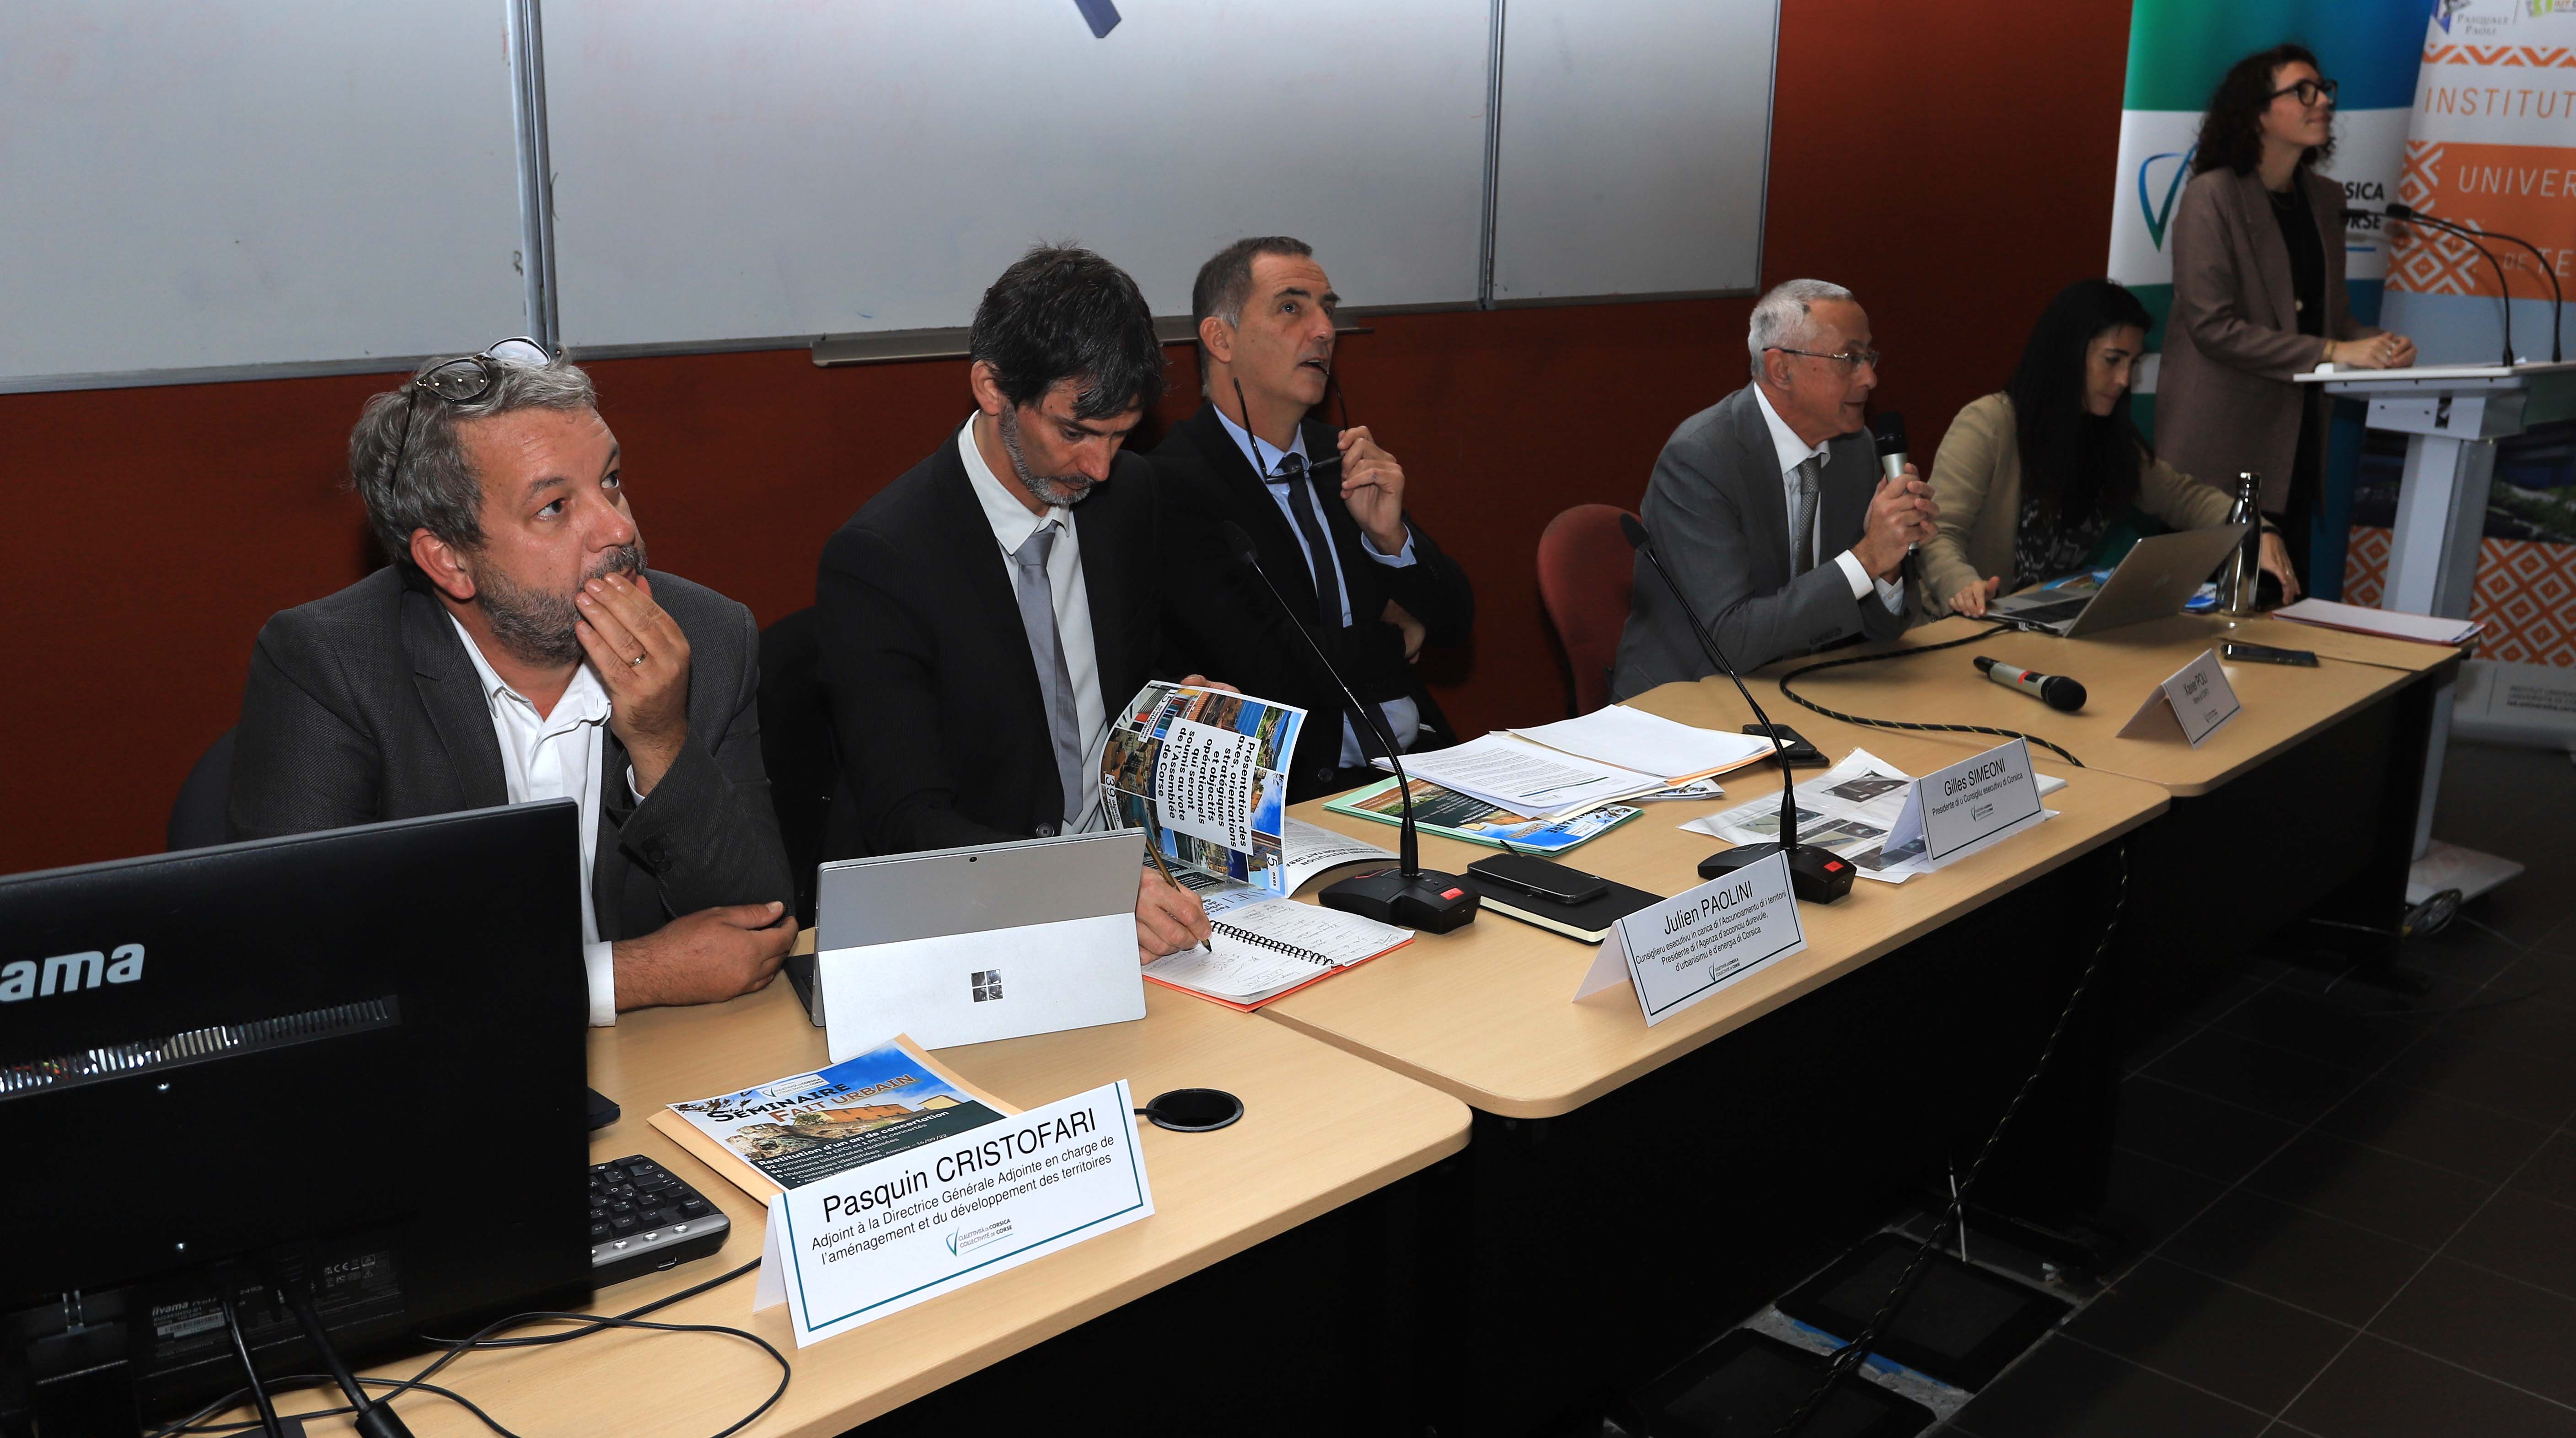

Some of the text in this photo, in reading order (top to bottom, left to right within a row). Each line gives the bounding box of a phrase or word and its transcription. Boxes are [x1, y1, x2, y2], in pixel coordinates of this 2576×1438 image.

[1161, 690, 1176, 703] 15
[1157, 744, 1171, 797] de Corse
[1167, 727, 1187, 819] de l'Assemblée
[1179, 730, 1196, 773] soumis
[1191, 748, 1200, 768] qui
[1106, 776, 1116, 797] 39
[1177, 776, 1185, 792] au
[1197, 739, 1213, 825] opérationnels
[1207, 751, 1220, 821] et objectifs
[1216, 747, 1231, 827] stratégiques
[1228, 735, 1245, 847] axes, orientations
[1238, 742, 1256, 847] Présentation des
[1932, 802, 1955, 816] Presidente
[1955, 798, 1960, 807] di
[1963, 789, 1983, 803] Cunsigliu
[1983, 781, 2003, 794] esecutivu
[2007, 772, 2024, 784] Corsica
[1944, 758, 2006, 796] Gilles SIMEONI
[1267, 856, 1278, 868] 5
[1300, 851, 1348, 865] RESTITUTION
[1211, 905, 1230, 913] Faire
[1664, 880, 1753, 935] Julien PAOLINI
[1635, 945, 1666, 965] Cunsiglieru
[1666, 934, 1691, 950] esecutivu
[1697, 924, 1713, 937] carica
[1713, 920, 1719, 928] di
[1719, 903, 1760, 925] l'Accunciamentu
[1760, 899, 1765, 908] di
[1765, 897, 1768, 906] i
[1661, 912, 1769, 966] Presidente di l'Agenza d'acconciu durevule,
[1675, 926, 1761, 972] d'urbanisimu è d'energia di Corsica
[0, 944, 145, 1002] ama
[768, 1074, 915, 1122] FAIT URBAIN
[757, 1148, 822, 1166] Restitution
[823, 1140, 848, 1151] d'un
[880, 1111, 950, 1134] concertation
[783, 1161, 820, 1172] réunions
[820, 1148, 864, 1163] bilatérales
[864, 1138, 900, 1151] réalisées
[798, 1166, 835, 1179] Centralité
[916, 1133, 948, 1146] 16/09/22
[868, 1135, 889, 1144] PETR
[889, 1123, 928, 1137] concertés
[784, 1162, 837, 1177] thématiques
[837, 1149, 880, 1164] identifiées
[823, 1107, 1096, 1223] Pasquin CRISTOFARI
[812, 1135, 1115, 1250] Adjoint à la Directrice Générale Adjointe en charge de
[821, 1152, 1112, 1265] l'aménagement et du développement des territoires
[960, 1232, 990, 1248] COLLECTIVITÉ
[996, 1224, 1013, 1234] CORSE
[988, 1218, 1011, 1230] CORSICA
